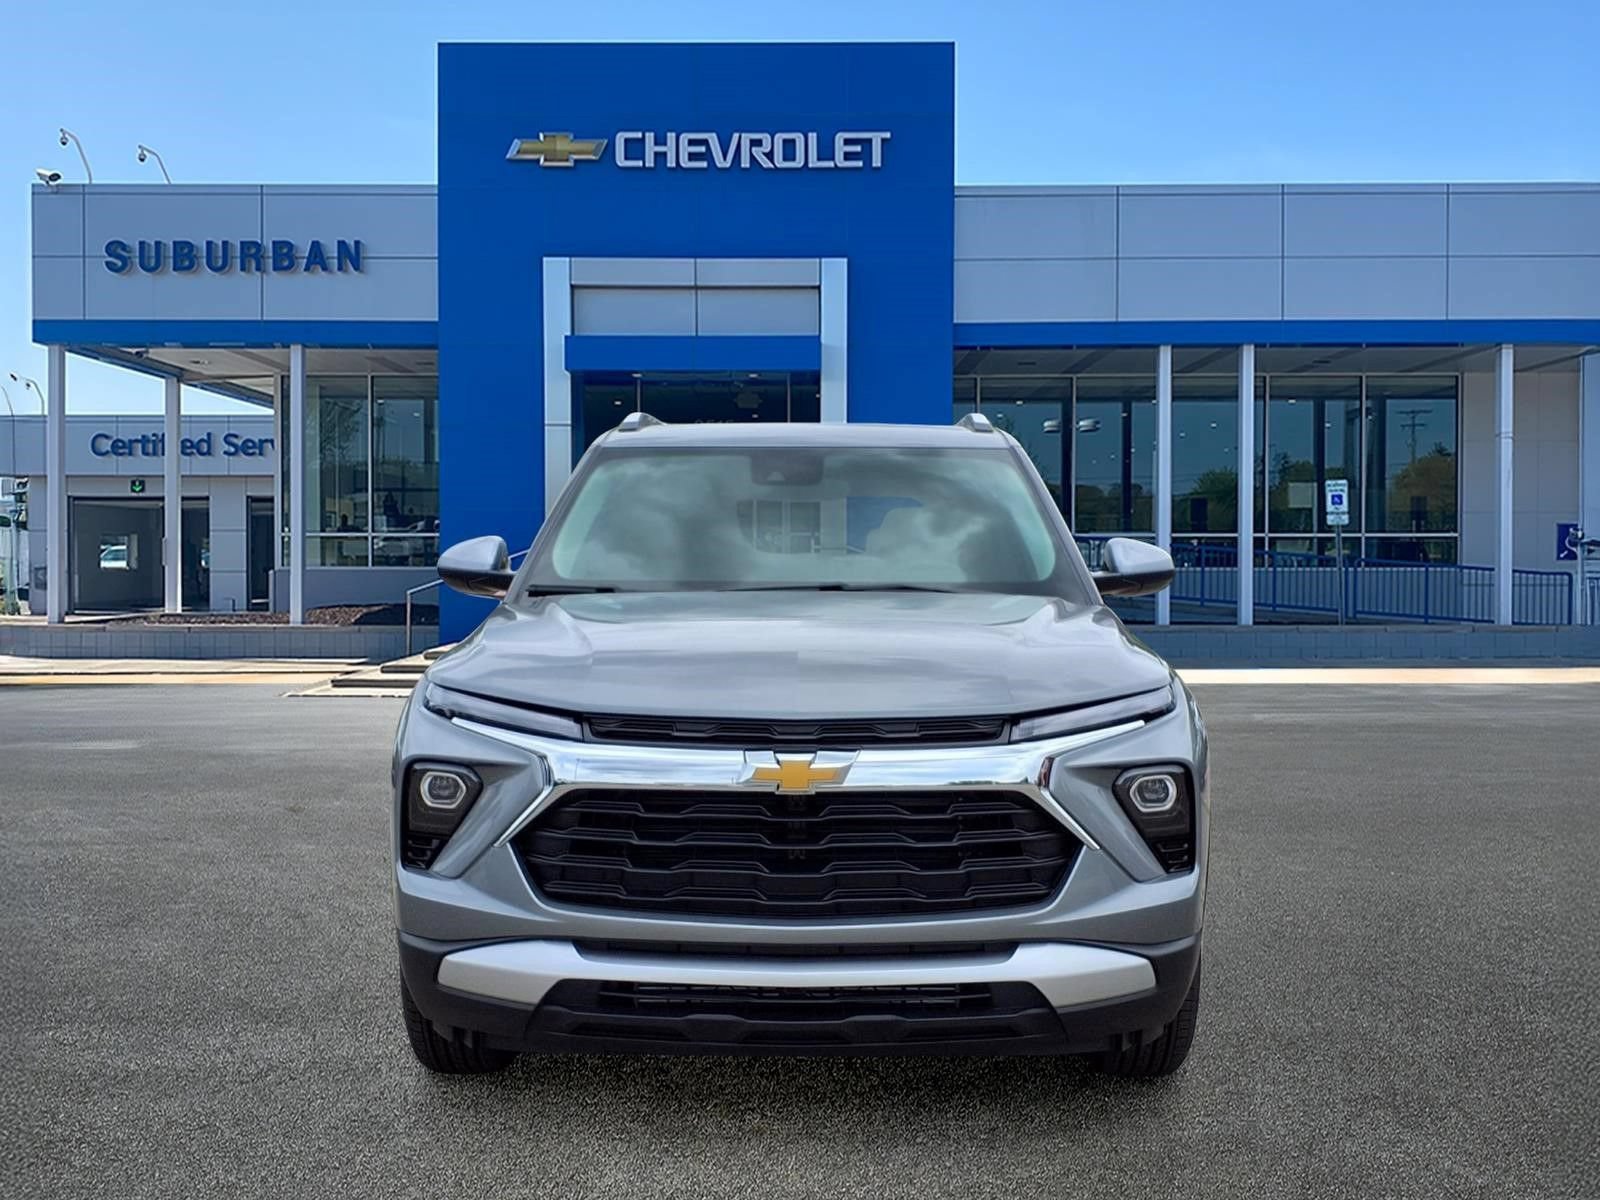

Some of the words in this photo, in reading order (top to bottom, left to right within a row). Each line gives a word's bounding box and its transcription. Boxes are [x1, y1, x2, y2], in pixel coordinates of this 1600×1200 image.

[614, 130, 892, 169] CHEVROLET
[103, 239, 363, 274] SUBURBAN
[90, 432, 213, 457] Certifed
